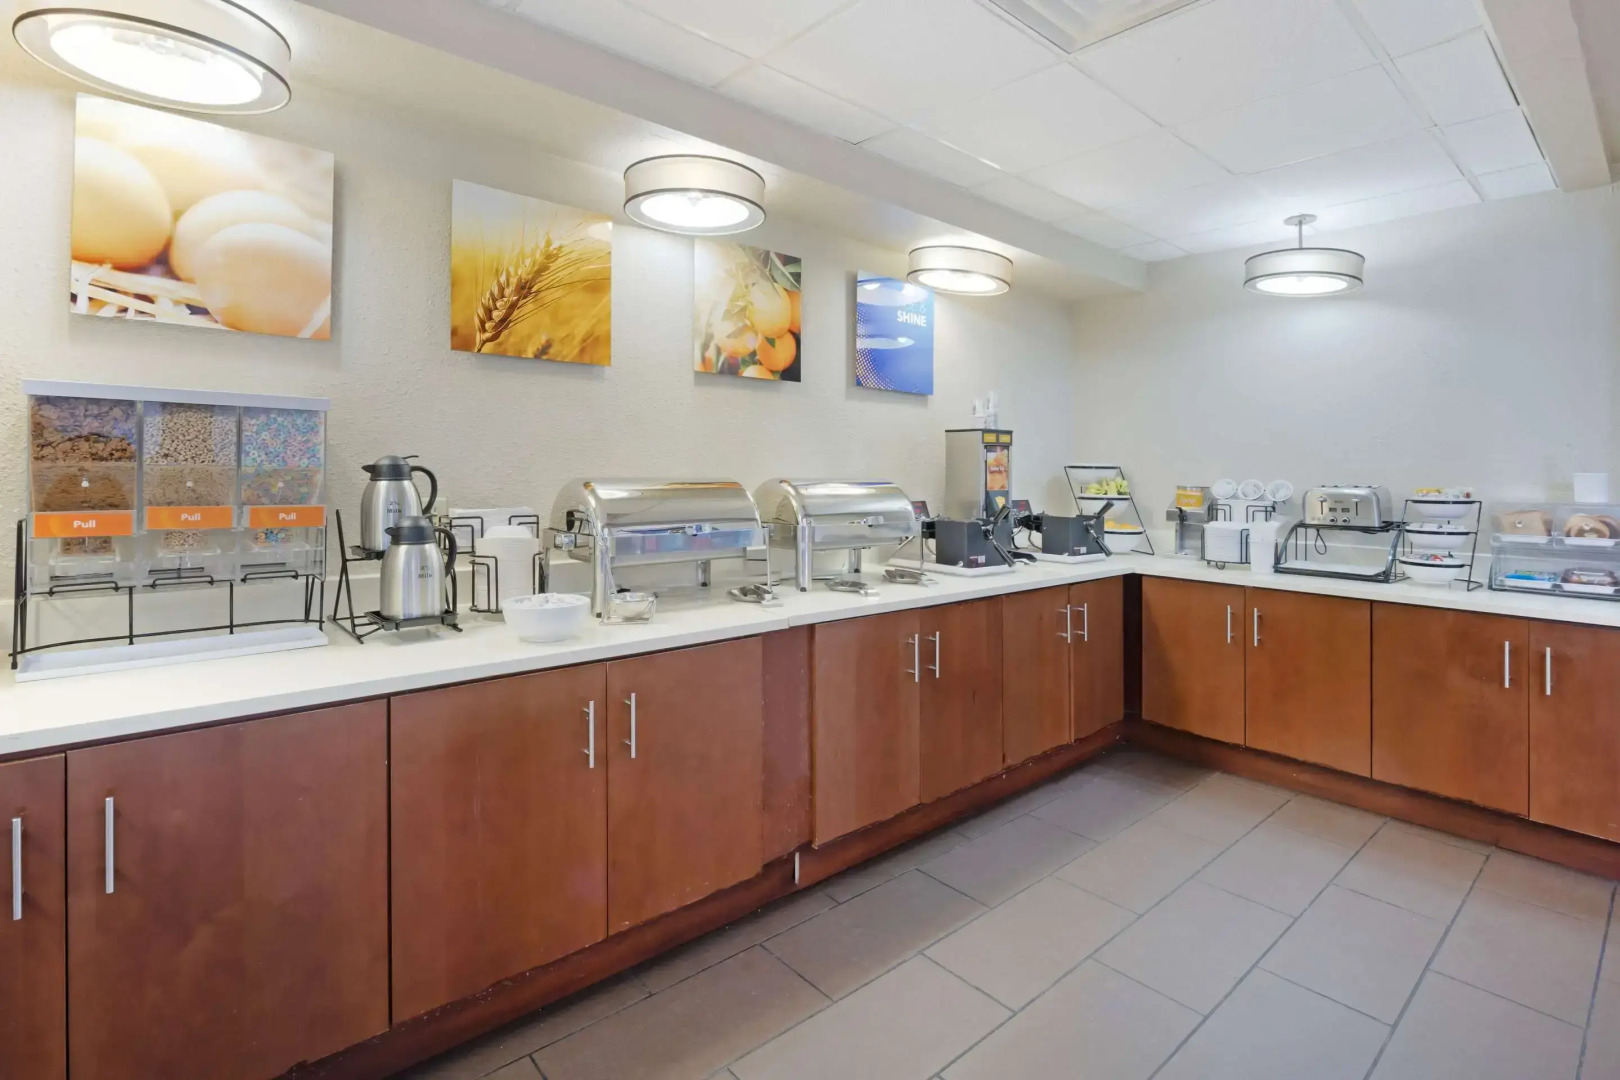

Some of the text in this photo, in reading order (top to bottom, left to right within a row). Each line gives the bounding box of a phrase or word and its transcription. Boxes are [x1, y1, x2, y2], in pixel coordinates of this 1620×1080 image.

[896, 310, 927, 327] SHINE
[180, 513, 201, 522] Pull
[278, 512, 297, 521] Pull
[73, 519, 96, 529] Pull
